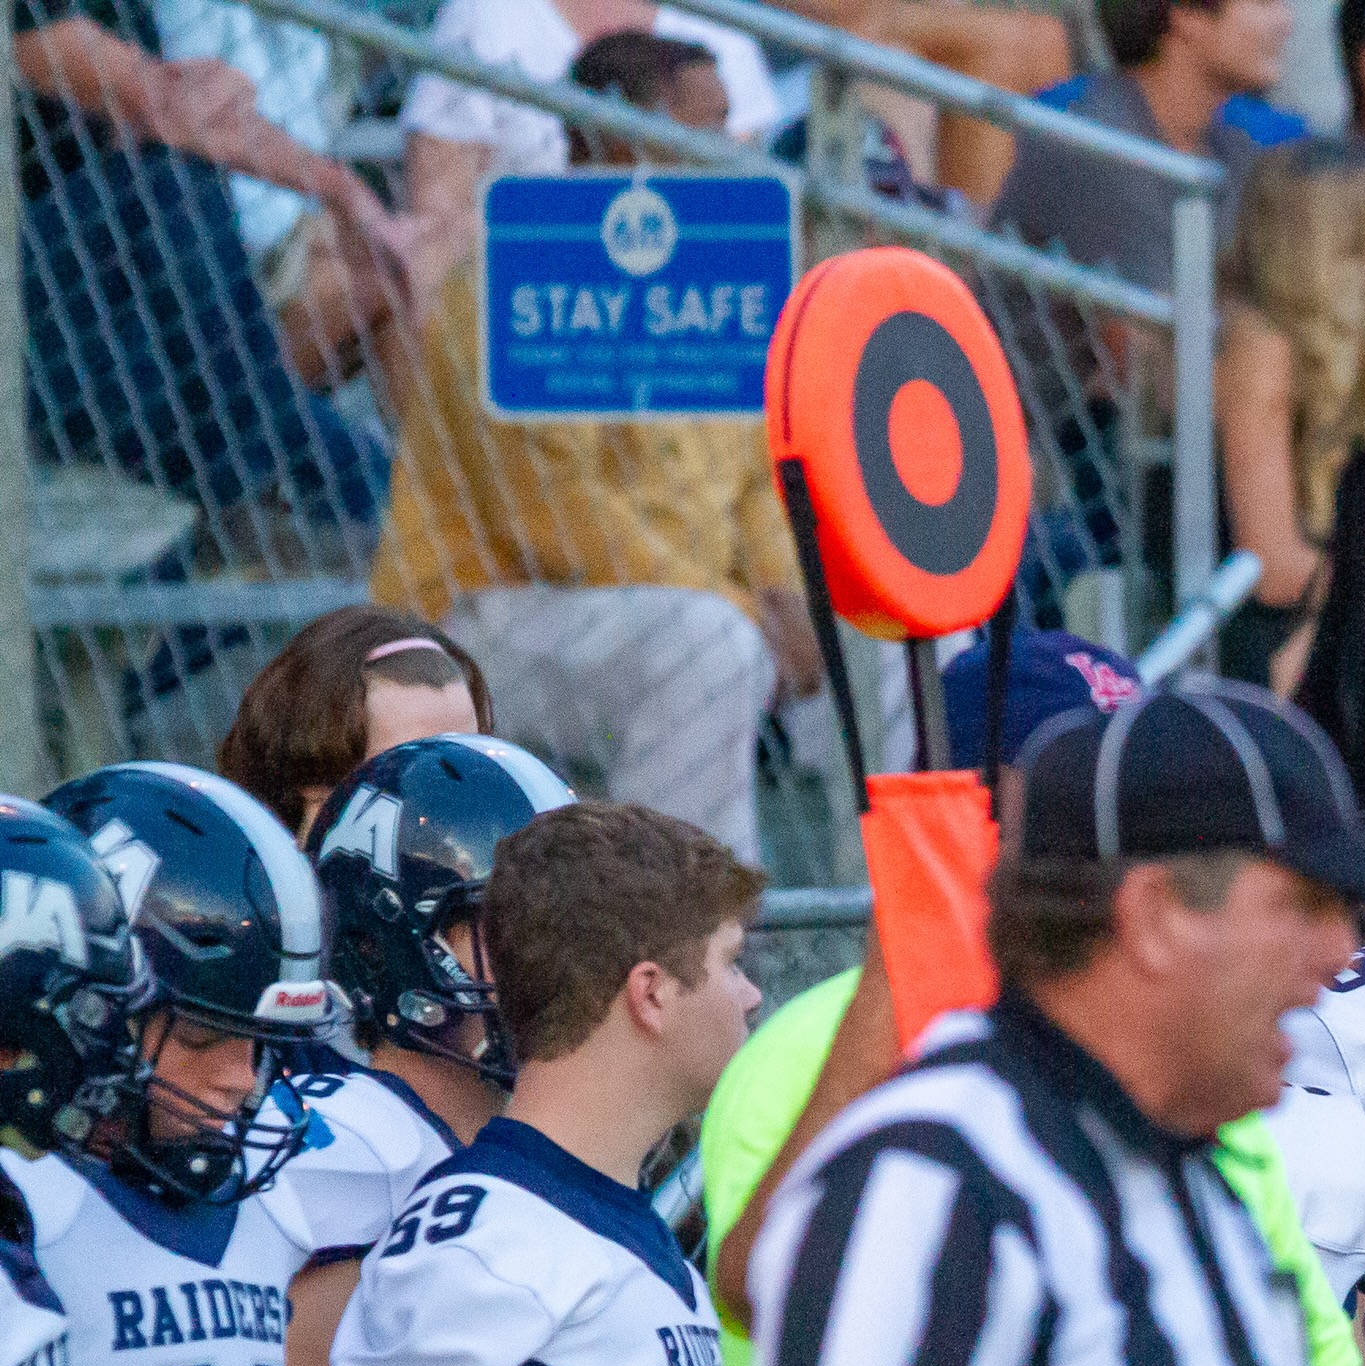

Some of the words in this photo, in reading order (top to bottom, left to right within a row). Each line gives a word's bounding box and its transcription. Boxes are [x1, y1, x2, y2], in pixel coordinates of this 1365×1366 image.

[511, 284, 609, 334] STAY
[646, 284, 768, 335] SAFE
[381, 1185, 489, 1258] 59
